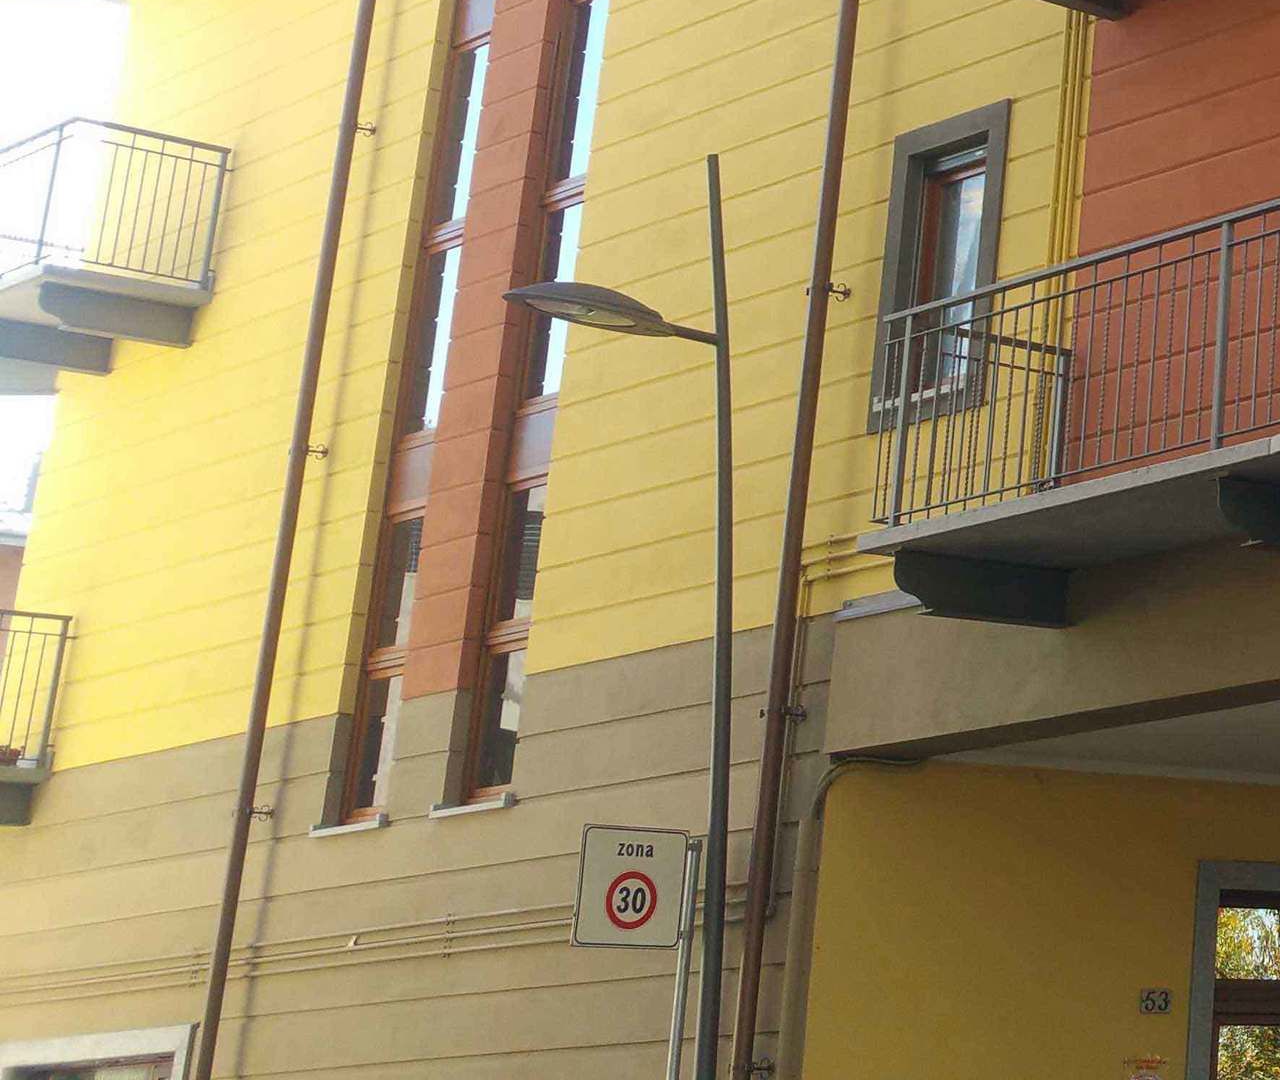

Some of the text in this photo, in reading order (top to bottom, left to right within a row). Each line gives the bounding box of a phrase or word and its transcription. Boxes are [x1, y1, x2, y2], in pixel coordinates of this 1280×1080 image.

[617, 842, 654, 858] zona
[616, 886, 646, 914] 30
[1144, 990, 1169, 1012] 53
